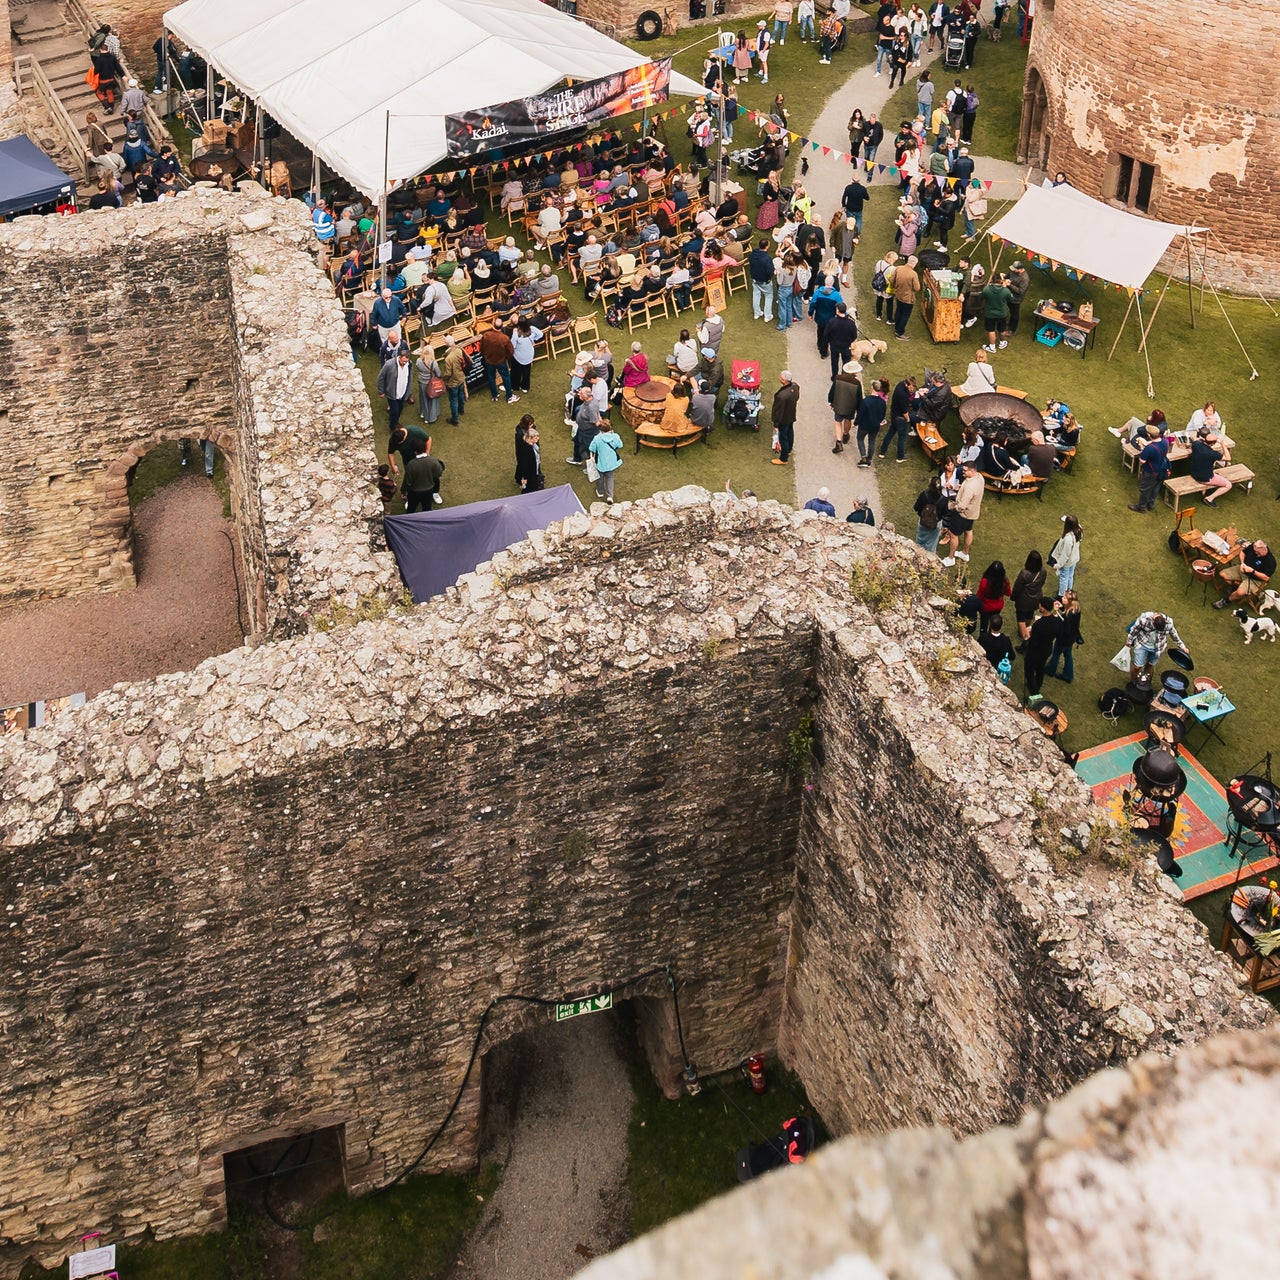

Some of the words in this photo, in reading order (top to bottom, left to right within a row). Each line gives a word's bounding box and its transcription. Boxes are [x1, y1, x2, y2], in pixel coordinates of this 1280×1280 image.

[553, 89, 574, 102] THE
[546, 96, 587, 120] FIRE
[545, 112, 587, 132] STAGE
[471, 122, 509, 140] Kadai
[559, 1003, 575, 1012] Fire
[559, 1010, 574, 1018] exit
